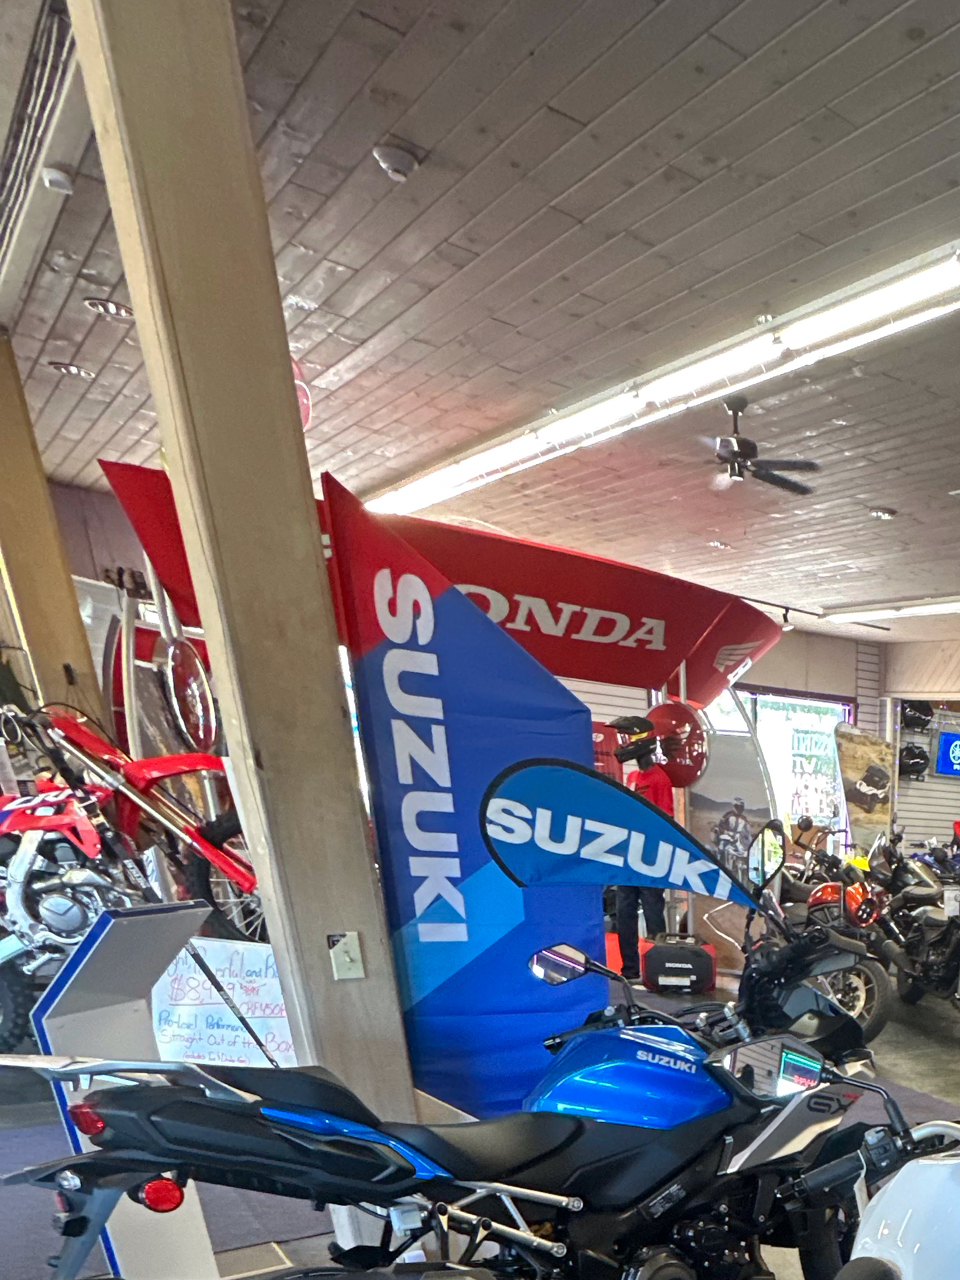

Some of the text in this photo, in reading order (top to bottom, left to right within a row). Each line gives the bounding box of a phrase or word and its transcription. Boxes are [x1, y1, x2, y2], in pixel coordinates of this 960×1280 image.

[453, 583, 667, 652] ONDA
[373, 568, 468, 942] SUZUKI
[485, 797, 733, 900] SUZUKI
[168, 974, 236, 1005] $8,99
[206, 1014, 246, 1033] Performanc
[207, 1034, 225, 1046] Out
[227, 1034, 241, 1047] of
[636, 1050, 697, 1074] SUZUKI
